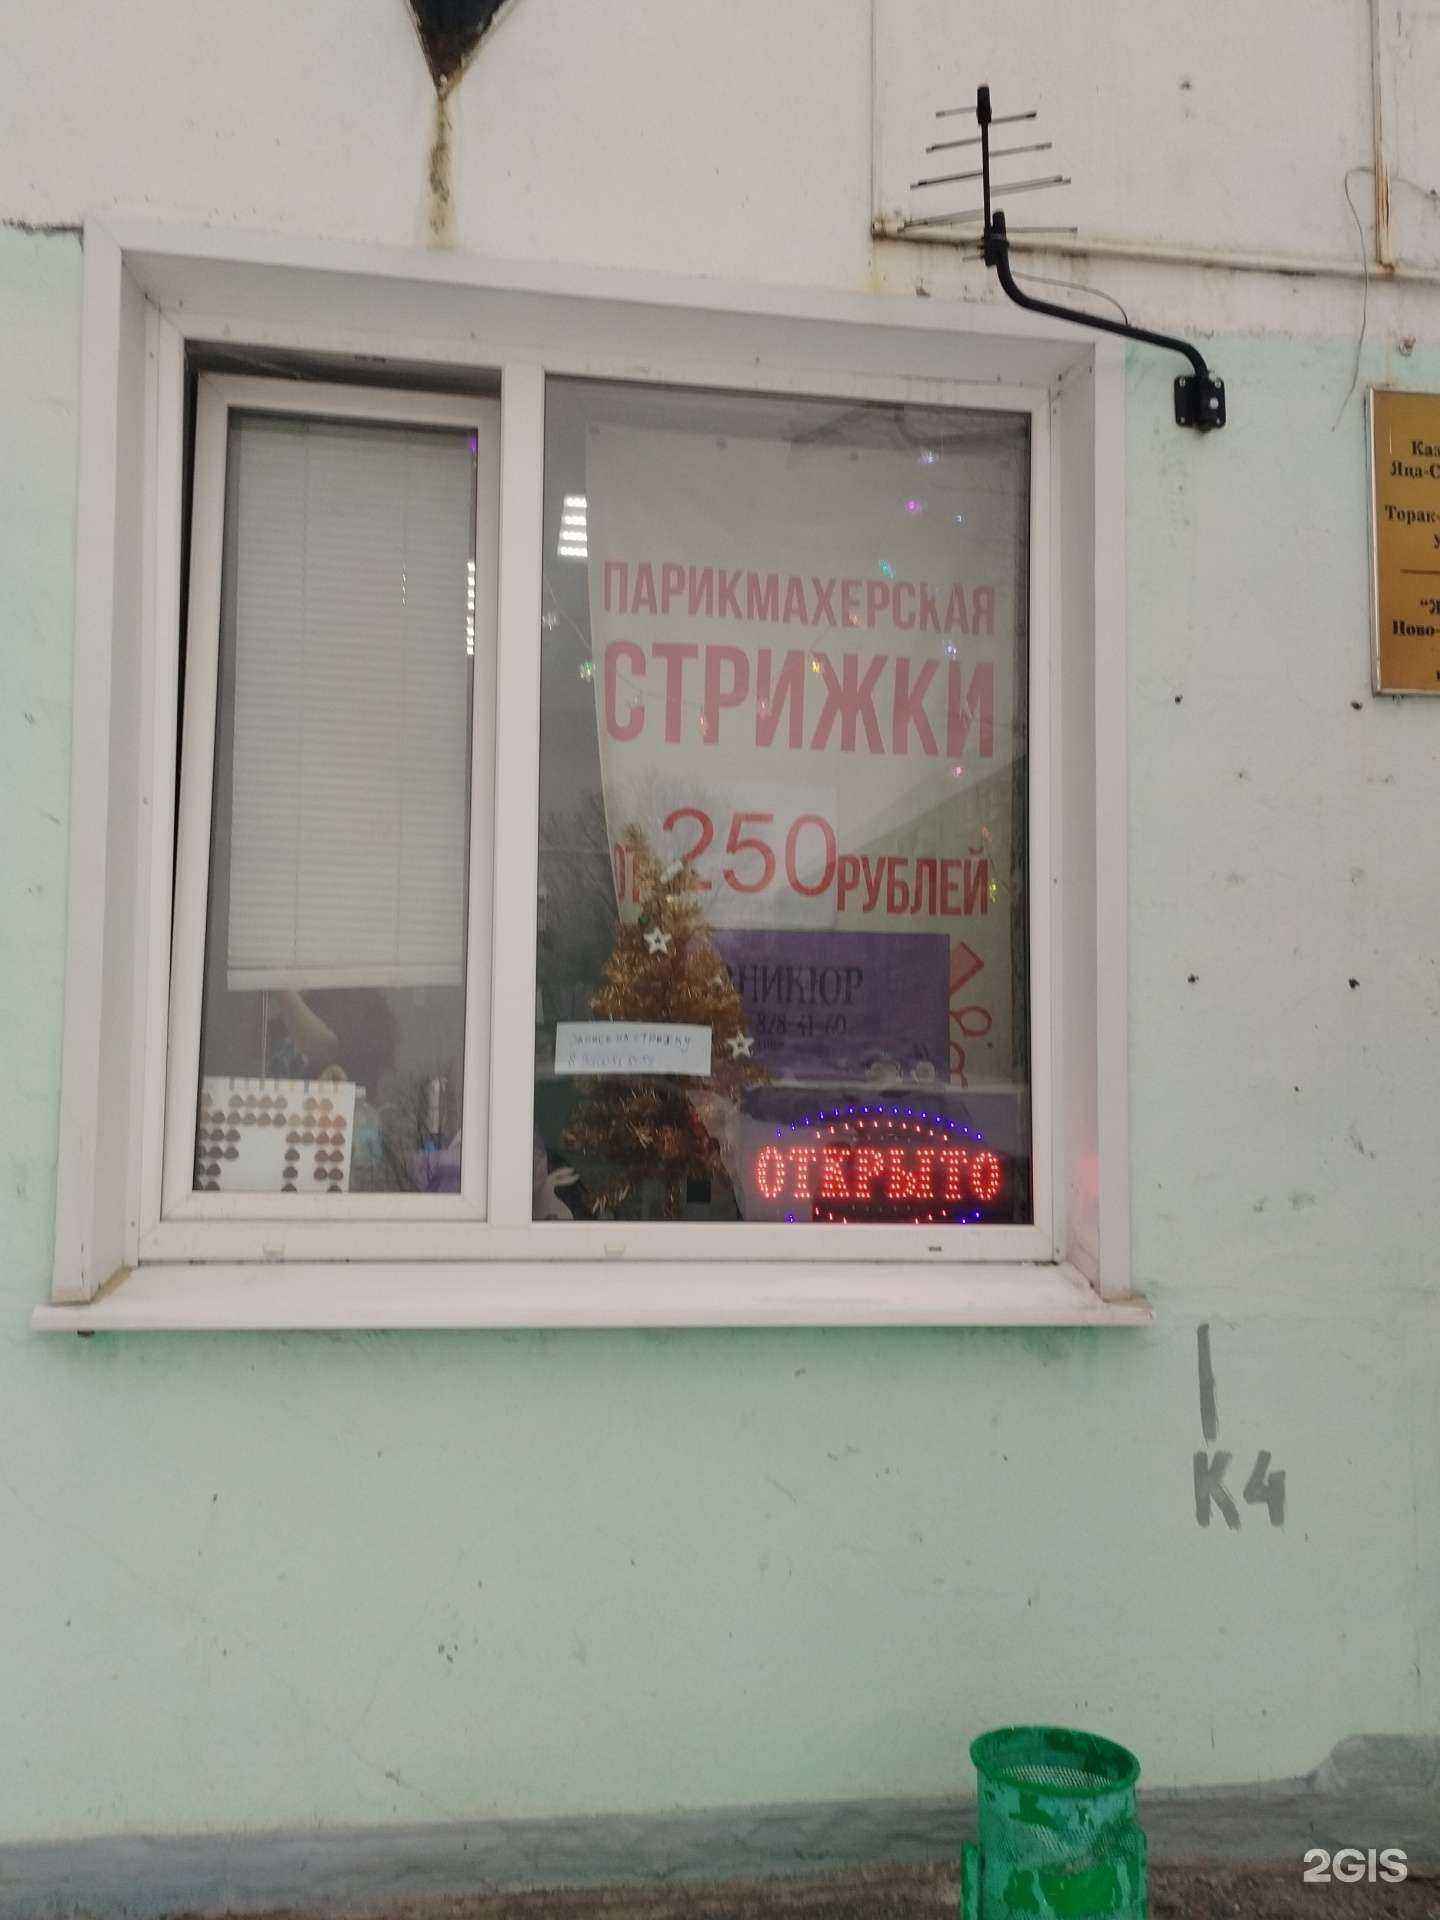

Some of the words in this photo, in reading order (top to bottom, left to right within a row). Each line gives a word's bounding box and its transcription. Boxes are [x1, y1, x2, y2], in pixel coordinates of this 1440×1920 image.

[603, 560, 994, 636] ПАРИКМАХЕРСКАЯ
[604, 640, 995, 759] СТРИЖКИ
[661, 807, 837, 898] 250
[836, 845, 990, 916] РУБЛЕЙ
[727, 963, 863, 1007] НИКЮР
[757, 1145, 1001, 1200] ОТКРЫТО
